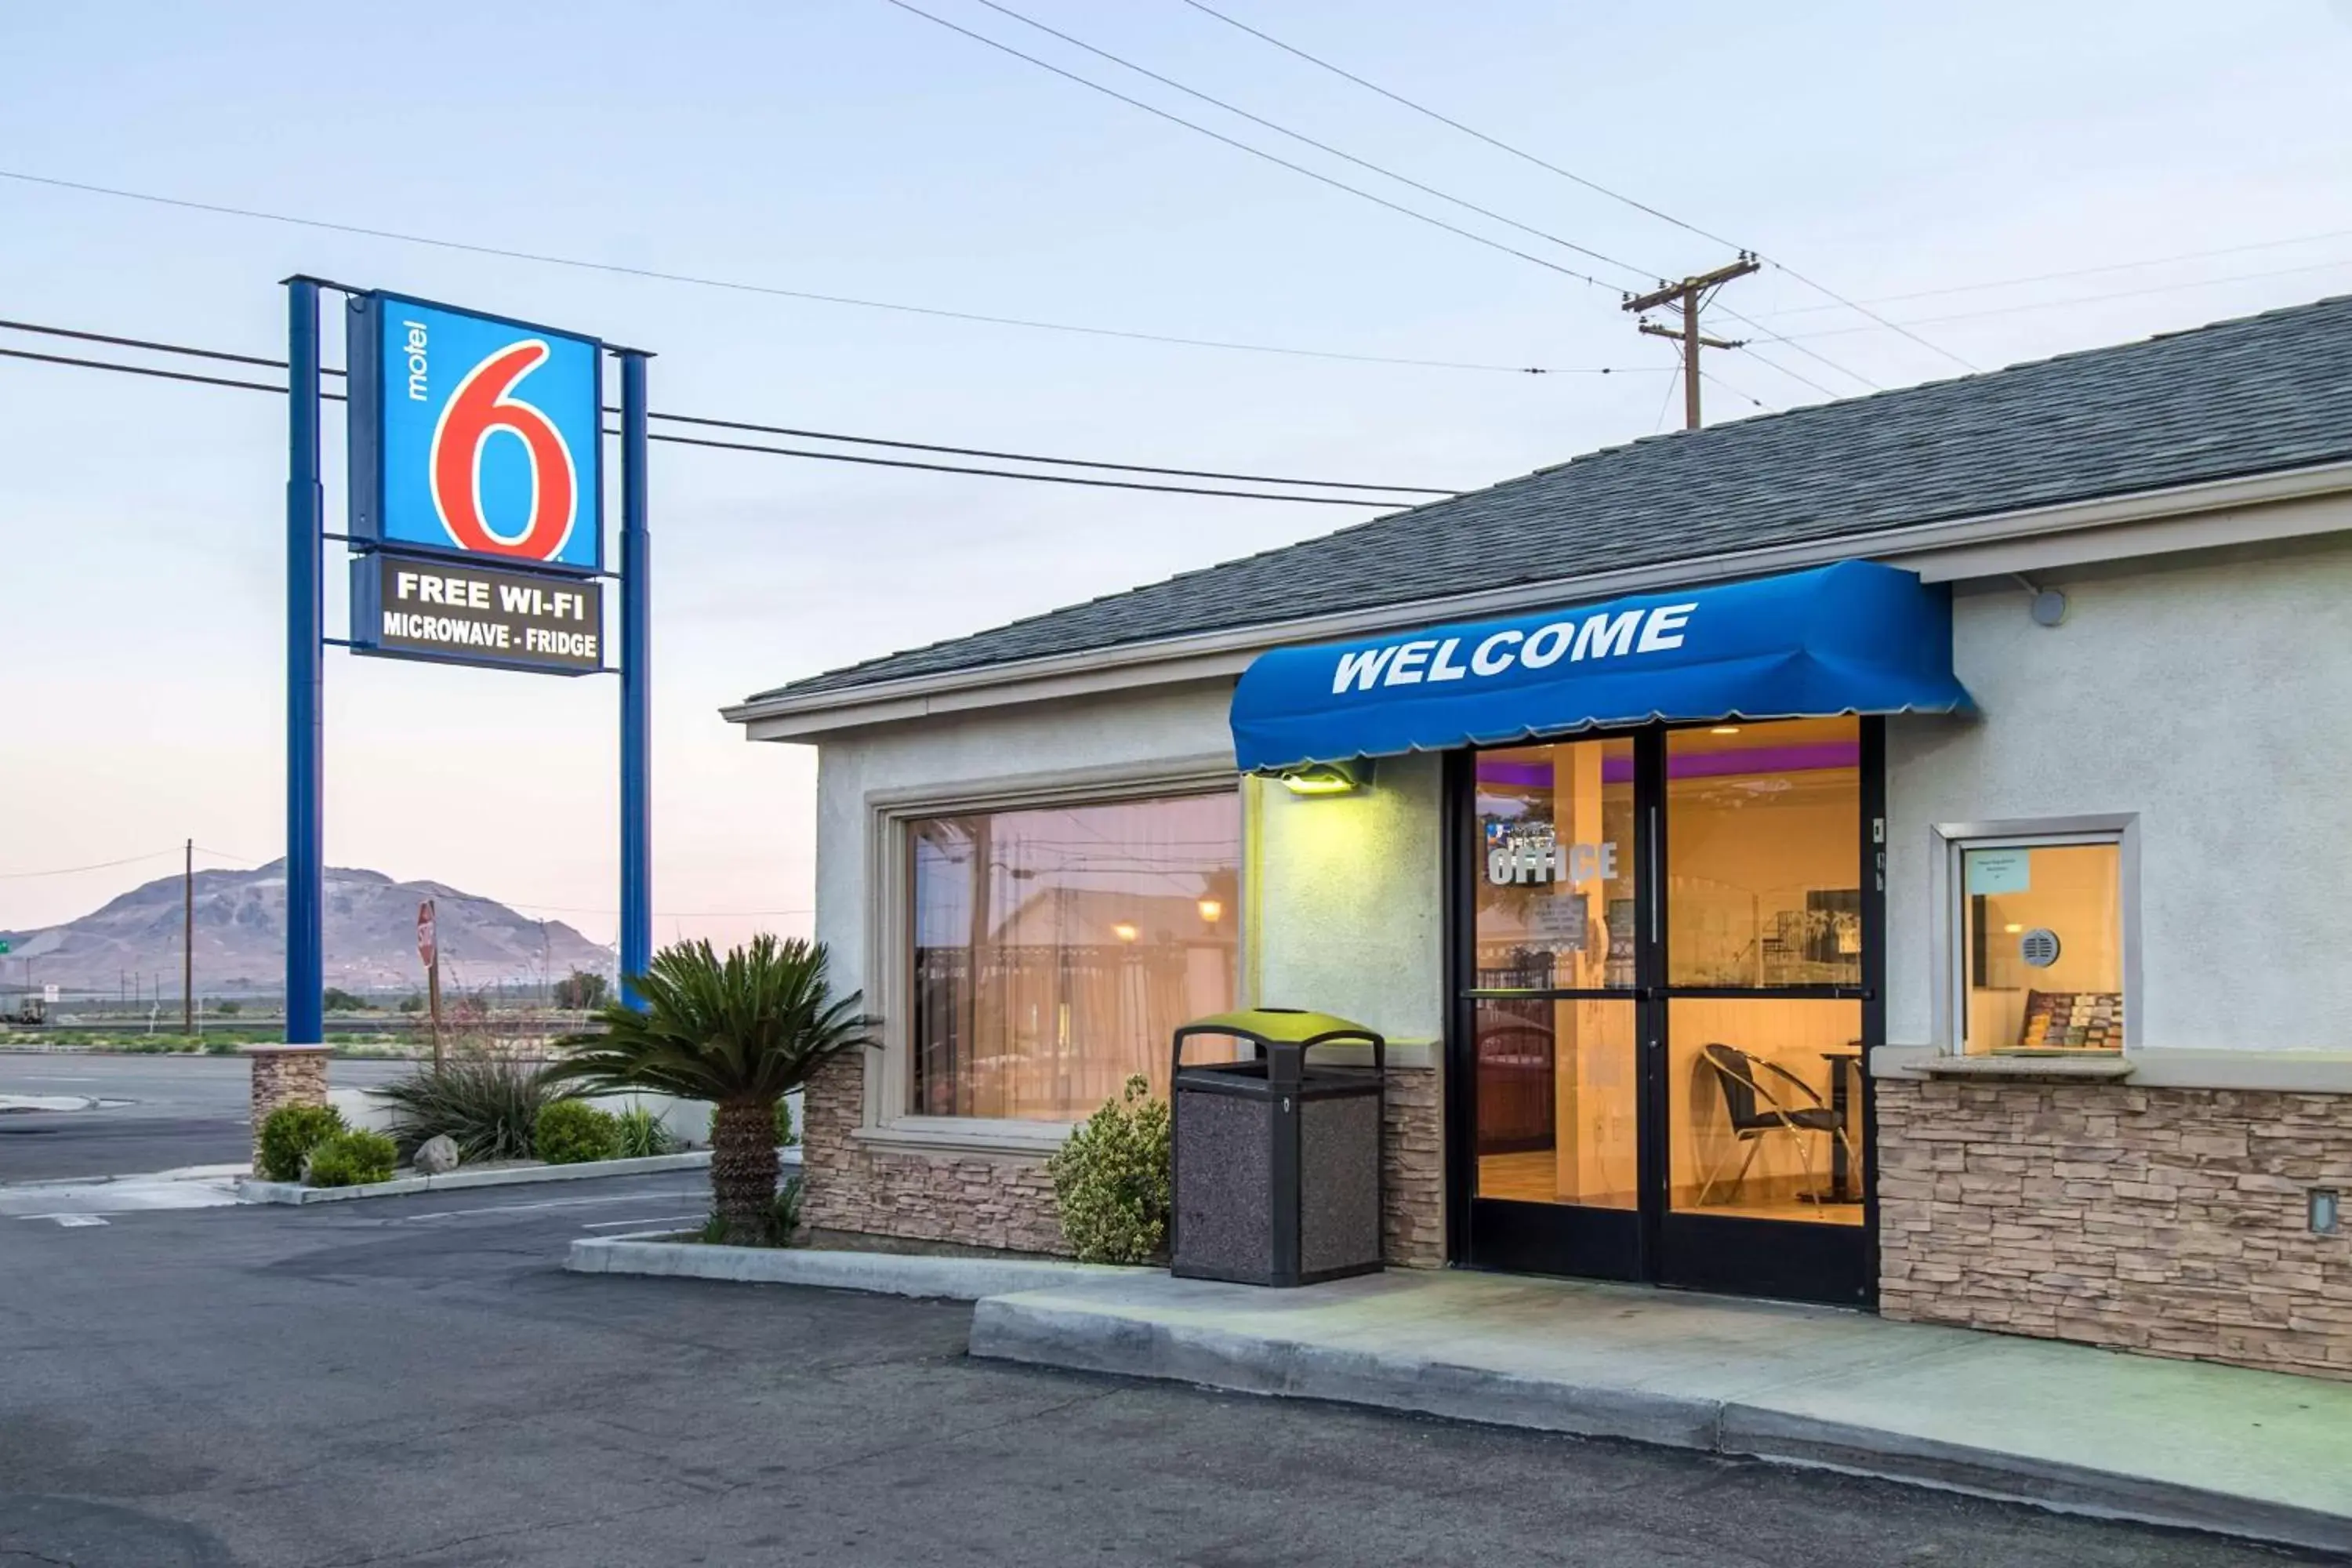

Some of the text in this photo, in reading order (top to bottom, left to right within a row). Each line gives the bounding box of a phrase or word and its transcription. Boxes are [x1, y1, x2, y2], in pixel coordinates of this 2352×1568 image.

[404, 321, 427, 401] motel
[430, 339, 578, 561] 6
[397, 572, 583, 620] FREE WI-FI
[383, 611, 510, 648] MICROWAVE
[526, 628, 597, 658] FRIDGE
[1332, 602, 1699, 694] WELCOME
[1489, 842, 1619, 885] OFFICE
